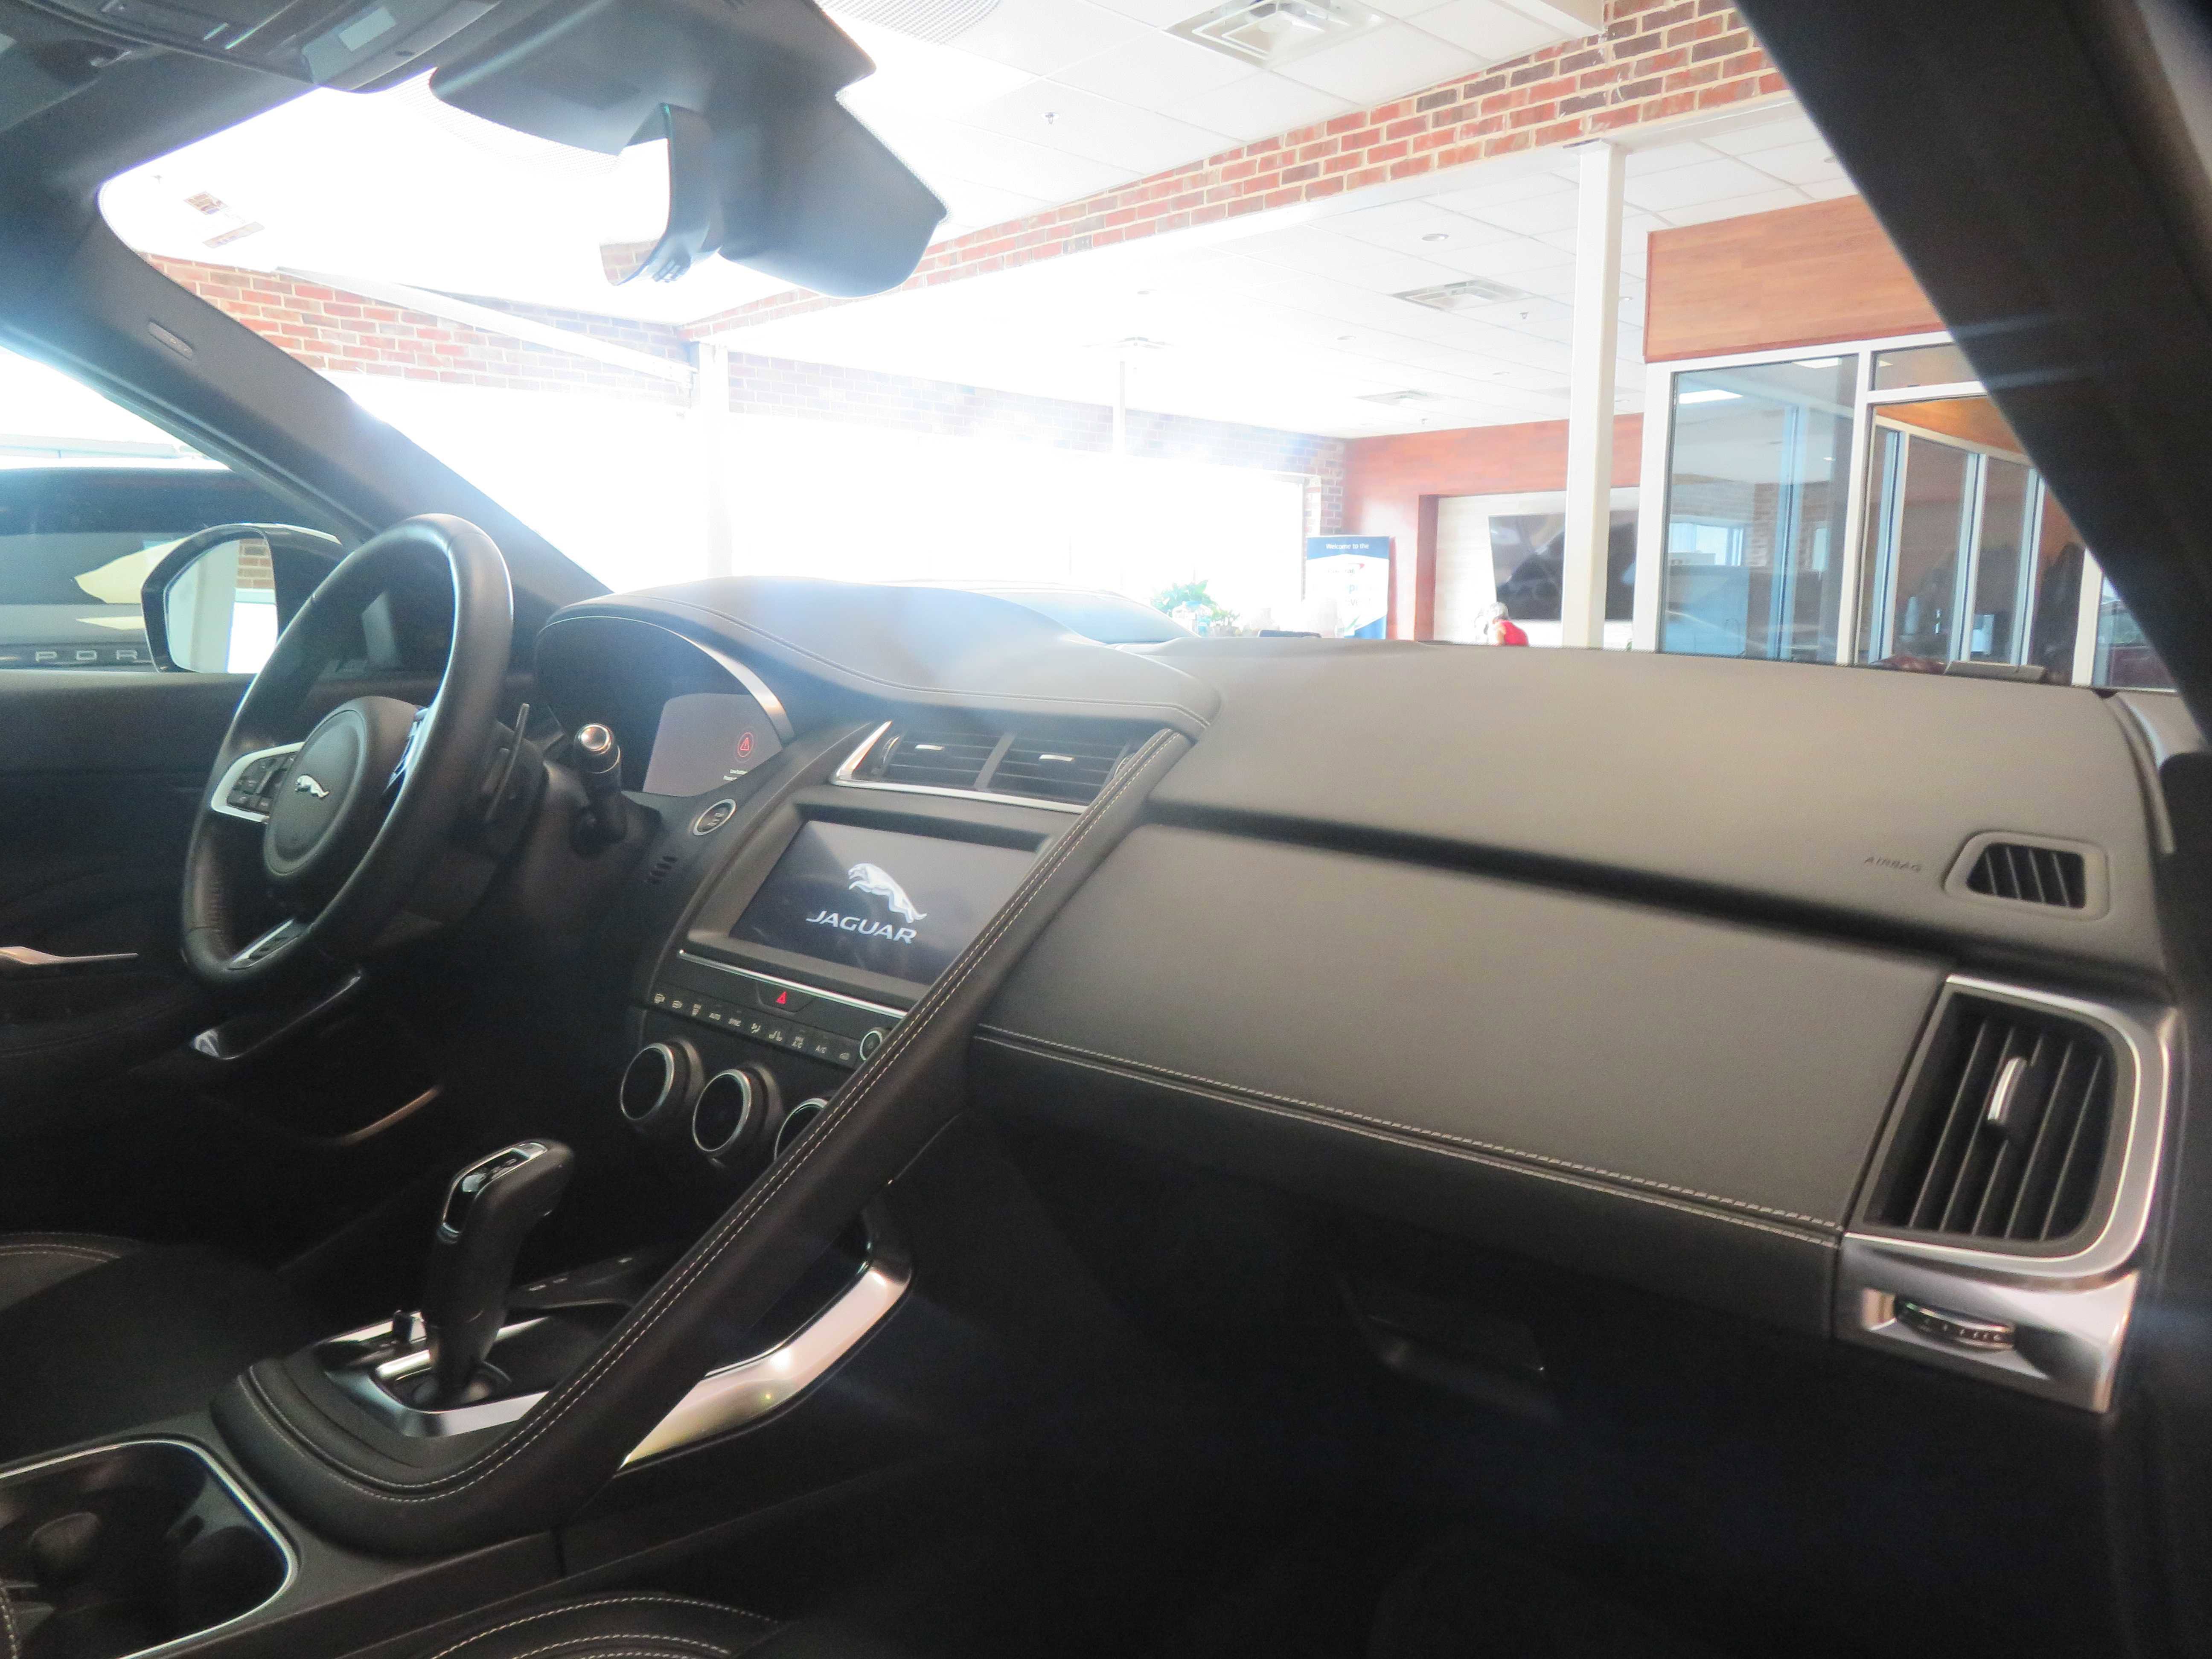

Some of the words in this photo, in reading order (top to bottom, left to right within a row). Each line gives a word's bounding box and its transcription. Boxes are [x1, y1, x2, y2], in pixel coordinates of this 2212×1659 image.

[1864, 856, 1921, 873] AIRBAG
[806, 910, 917, 944] JAGUAR
[815, 1045, 827, 1054] A/C
